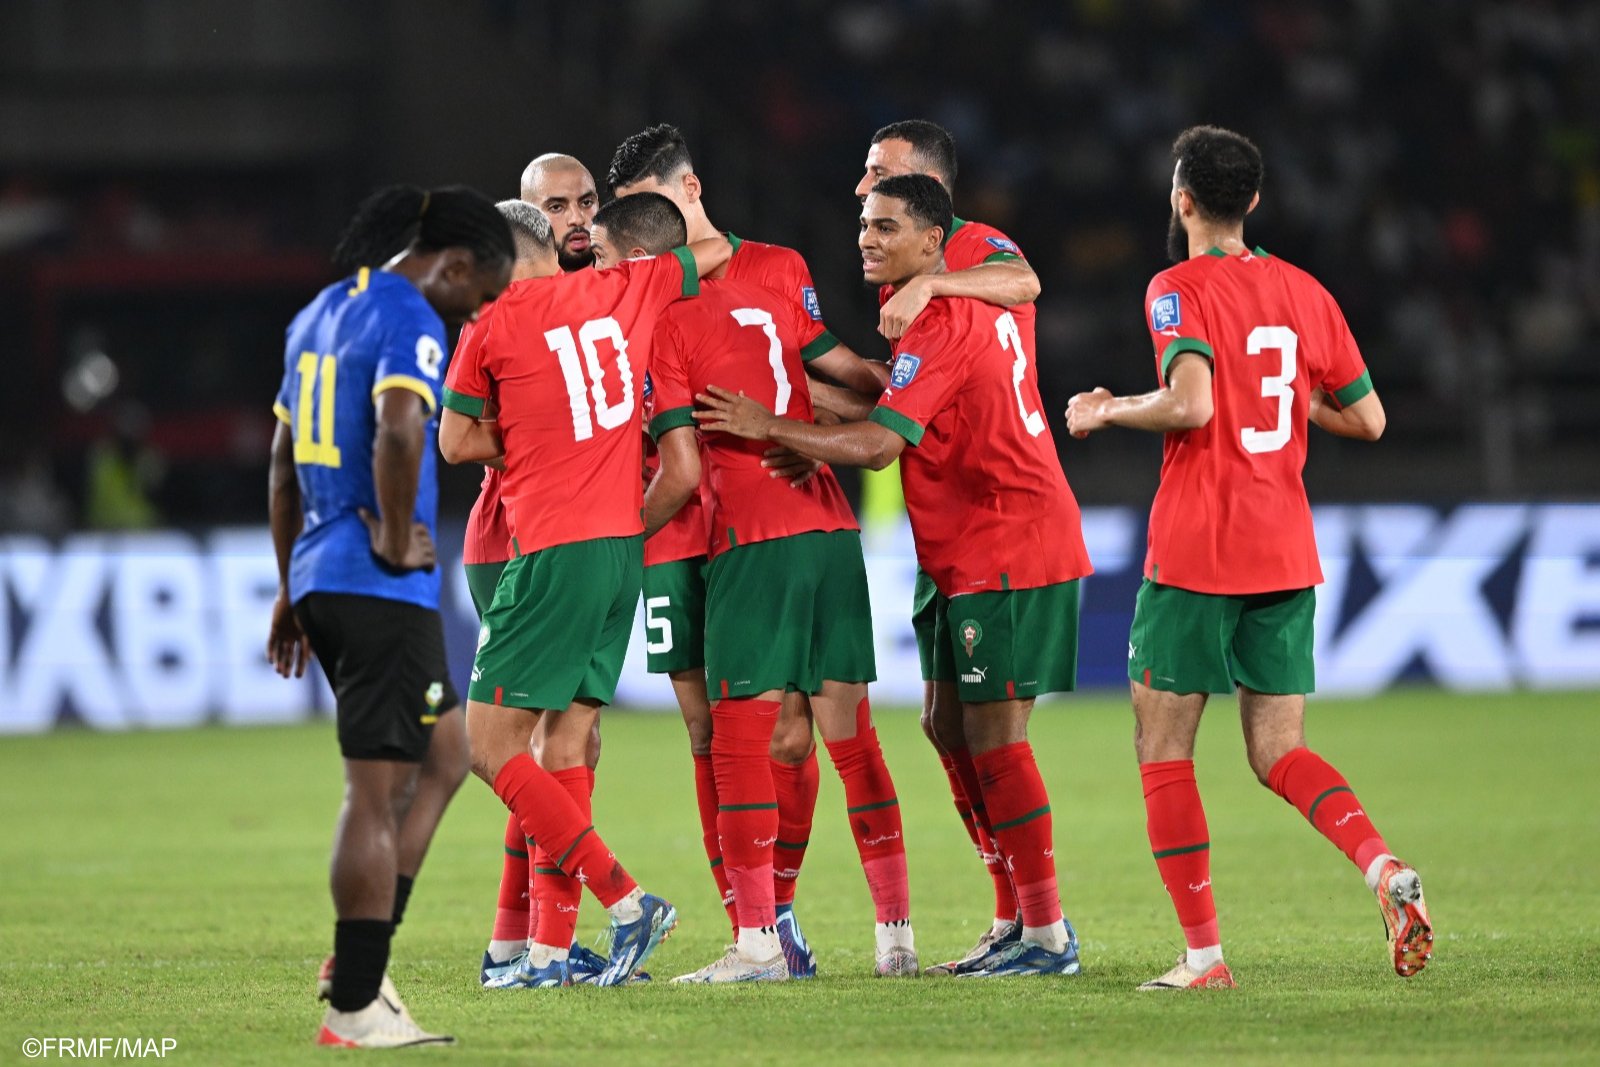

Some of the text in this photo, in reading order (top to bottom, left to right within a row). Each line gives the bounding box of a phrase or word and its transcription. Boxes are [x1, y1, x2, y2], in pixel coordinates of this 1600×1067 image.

[293, 352, 341, 468] 11
[544, 316, 634, 442] 10
[730, 308, 792, 416] 7
[995, 311, 1046, 438] 2
[1240, 325, 1298, 454] 3
[0, 532, 312, 733] XBE
[646, 596, 673, 655] 5
